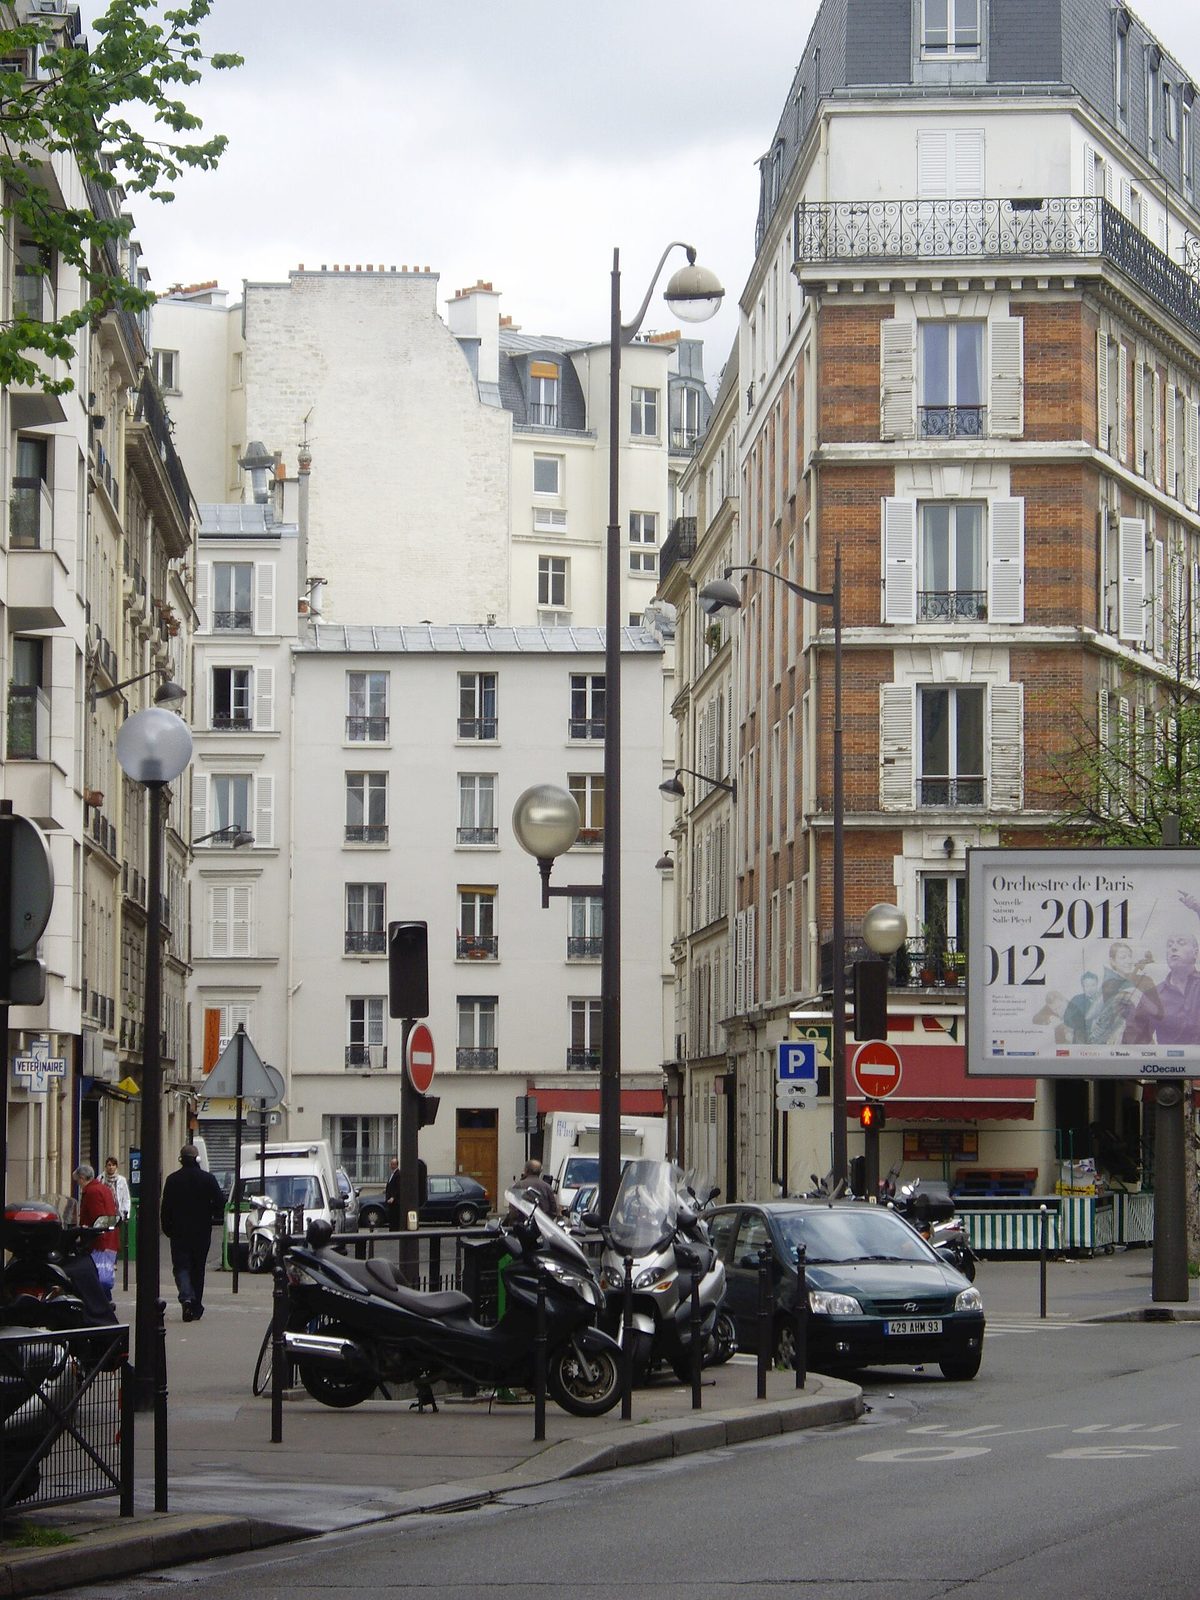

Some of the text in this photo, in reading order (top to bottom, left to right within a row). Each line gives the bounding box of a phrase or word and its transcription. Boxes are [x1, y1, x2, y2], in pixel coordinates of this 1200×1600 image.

[992, 875, 1134, 891] Orchestre de Paris
[993, 898, 1023, 906] Nouvelle
[993, 906, 1015, 914] saison
[993, 915, 1032, 925] Salle Pleyel
[1040, 898, 1134, 939] 2011
[788, 1049, 806, 1074] P
[1140, 1064, 1186, 1073] JCDecaux
[890, 1321, 939, 1333] 429 AHM 93
